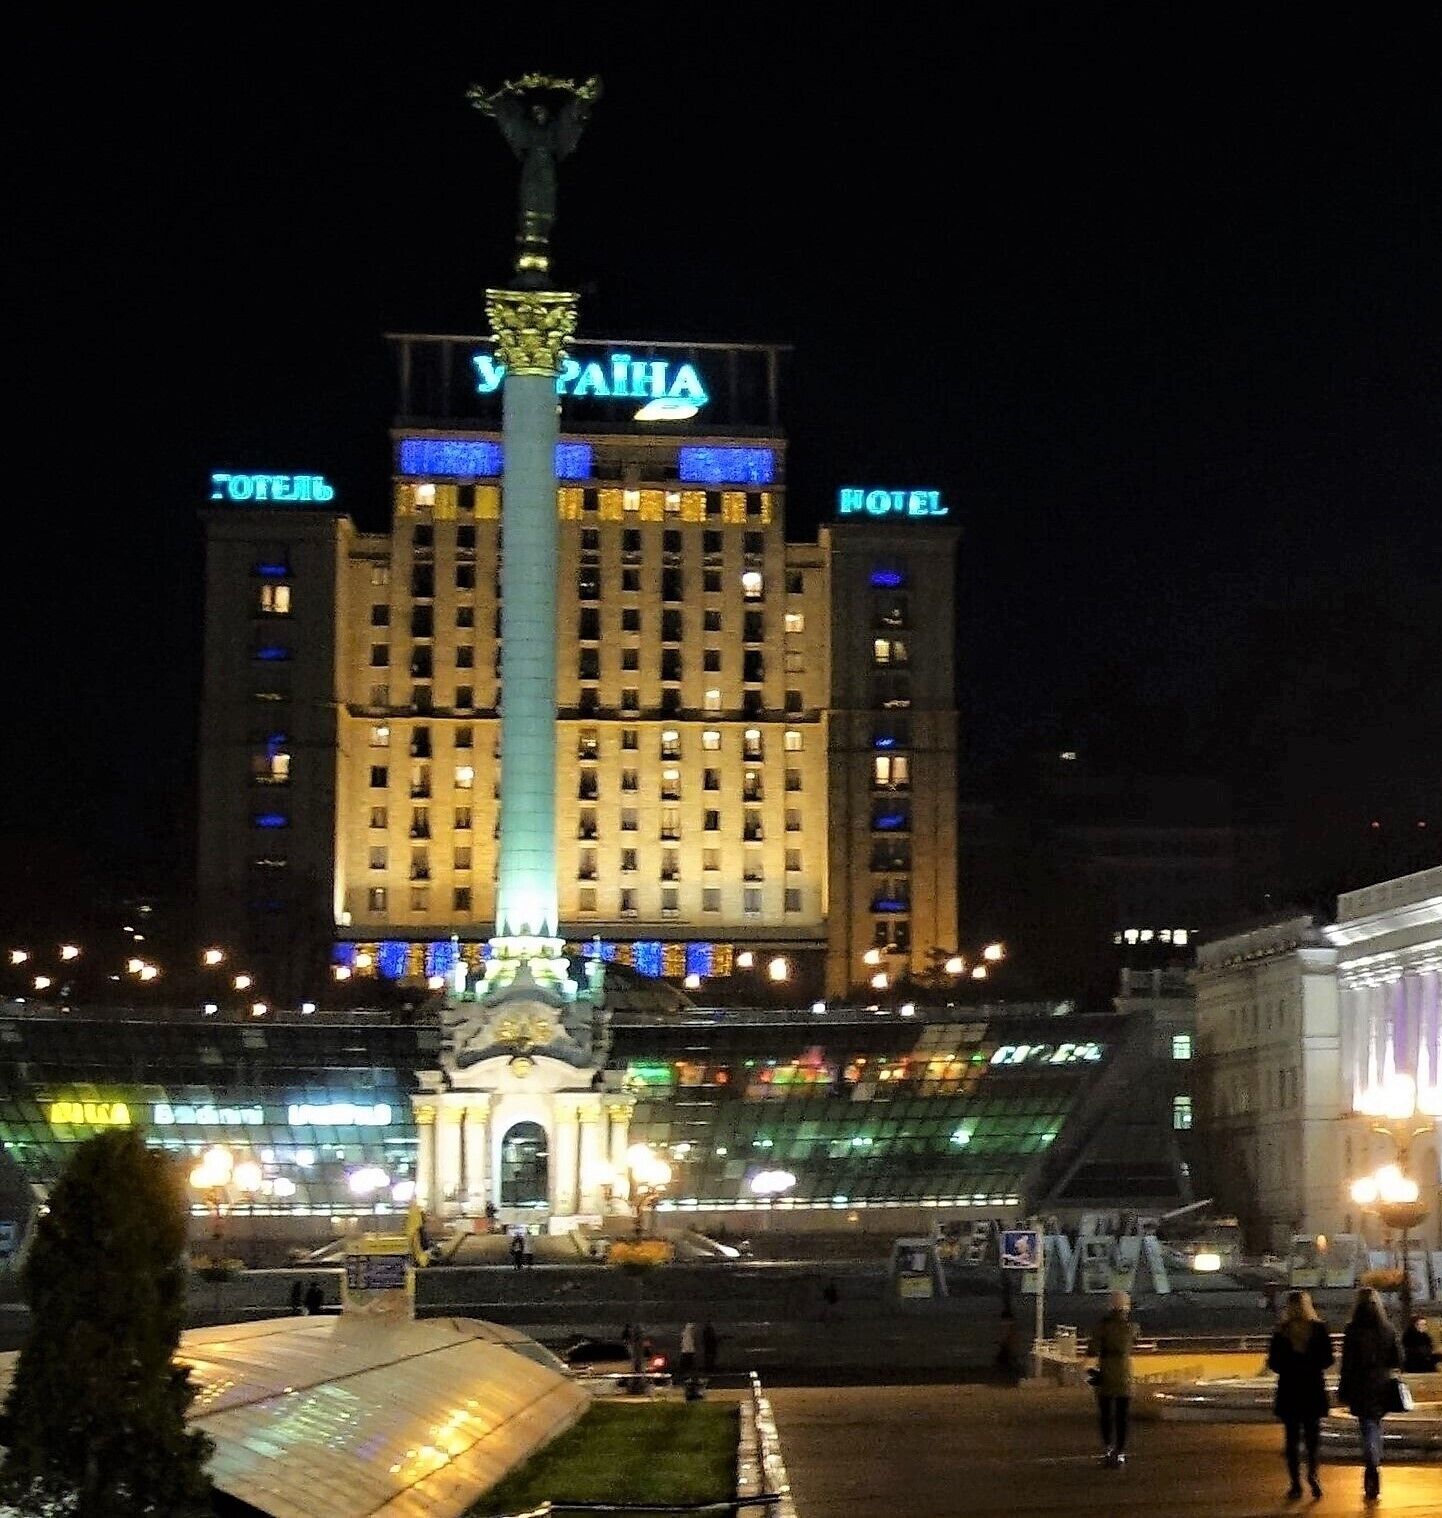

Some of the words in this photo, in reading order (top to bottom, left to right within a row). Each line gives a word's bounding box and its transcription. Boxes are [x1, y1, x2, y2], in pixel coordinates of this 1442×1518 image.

[472, 353, 708, 404] УРАЇНА
[211, 473, 334, 501] ГОТЕЛЬ
[840, 488, 949, 515] HOTEL
